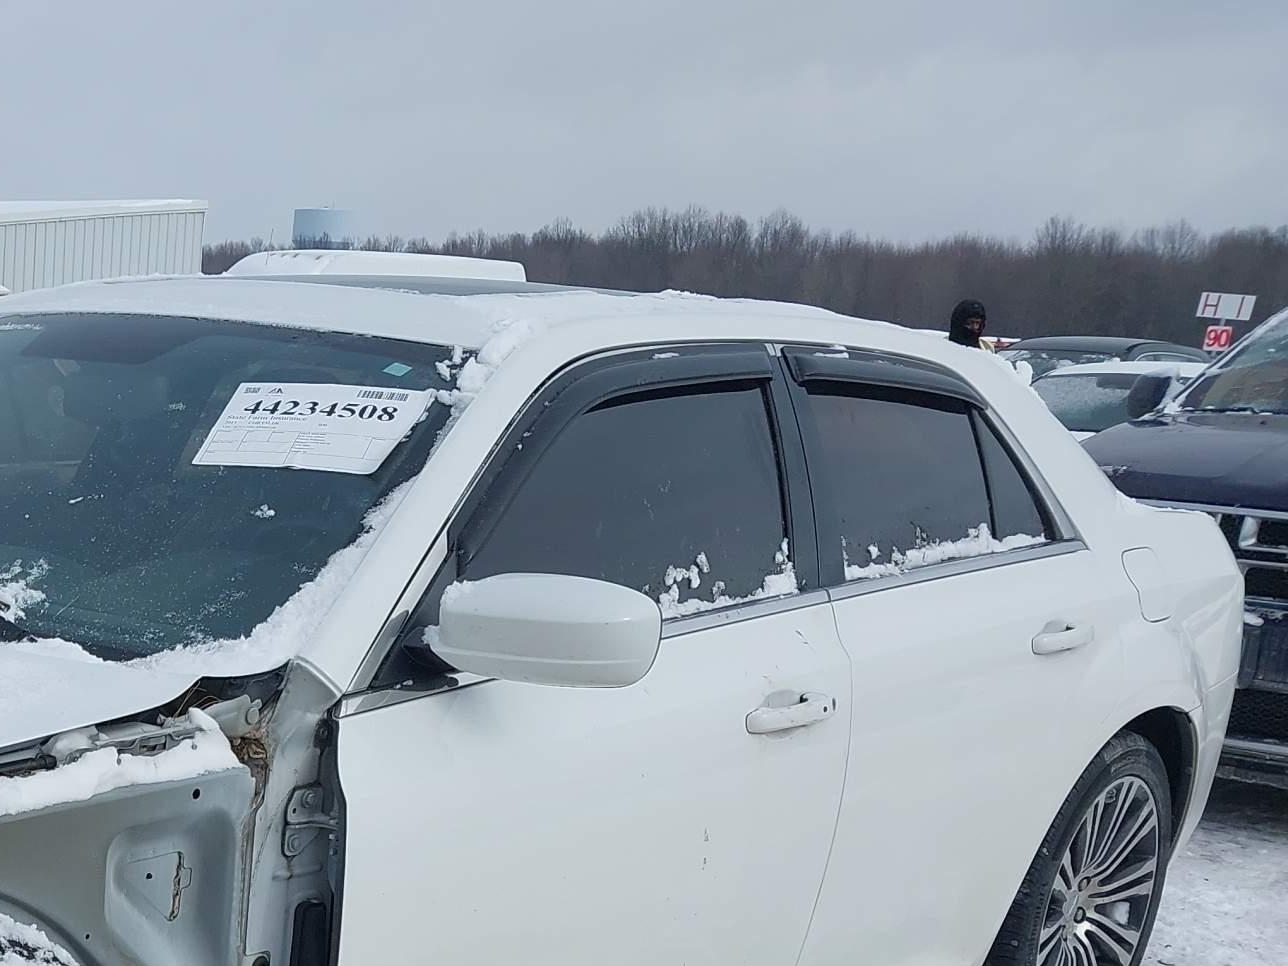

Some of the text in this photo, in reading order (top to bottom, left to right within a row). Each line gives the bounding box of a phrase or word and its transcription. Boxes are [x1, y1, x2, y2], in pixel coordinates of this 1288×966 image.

[1201, 294, 1222, 317] H
[1206, 329, 1230, 348] 90
[243, 399, 398, 422] 44234508
[270, 414, 308, 423] Insurance
